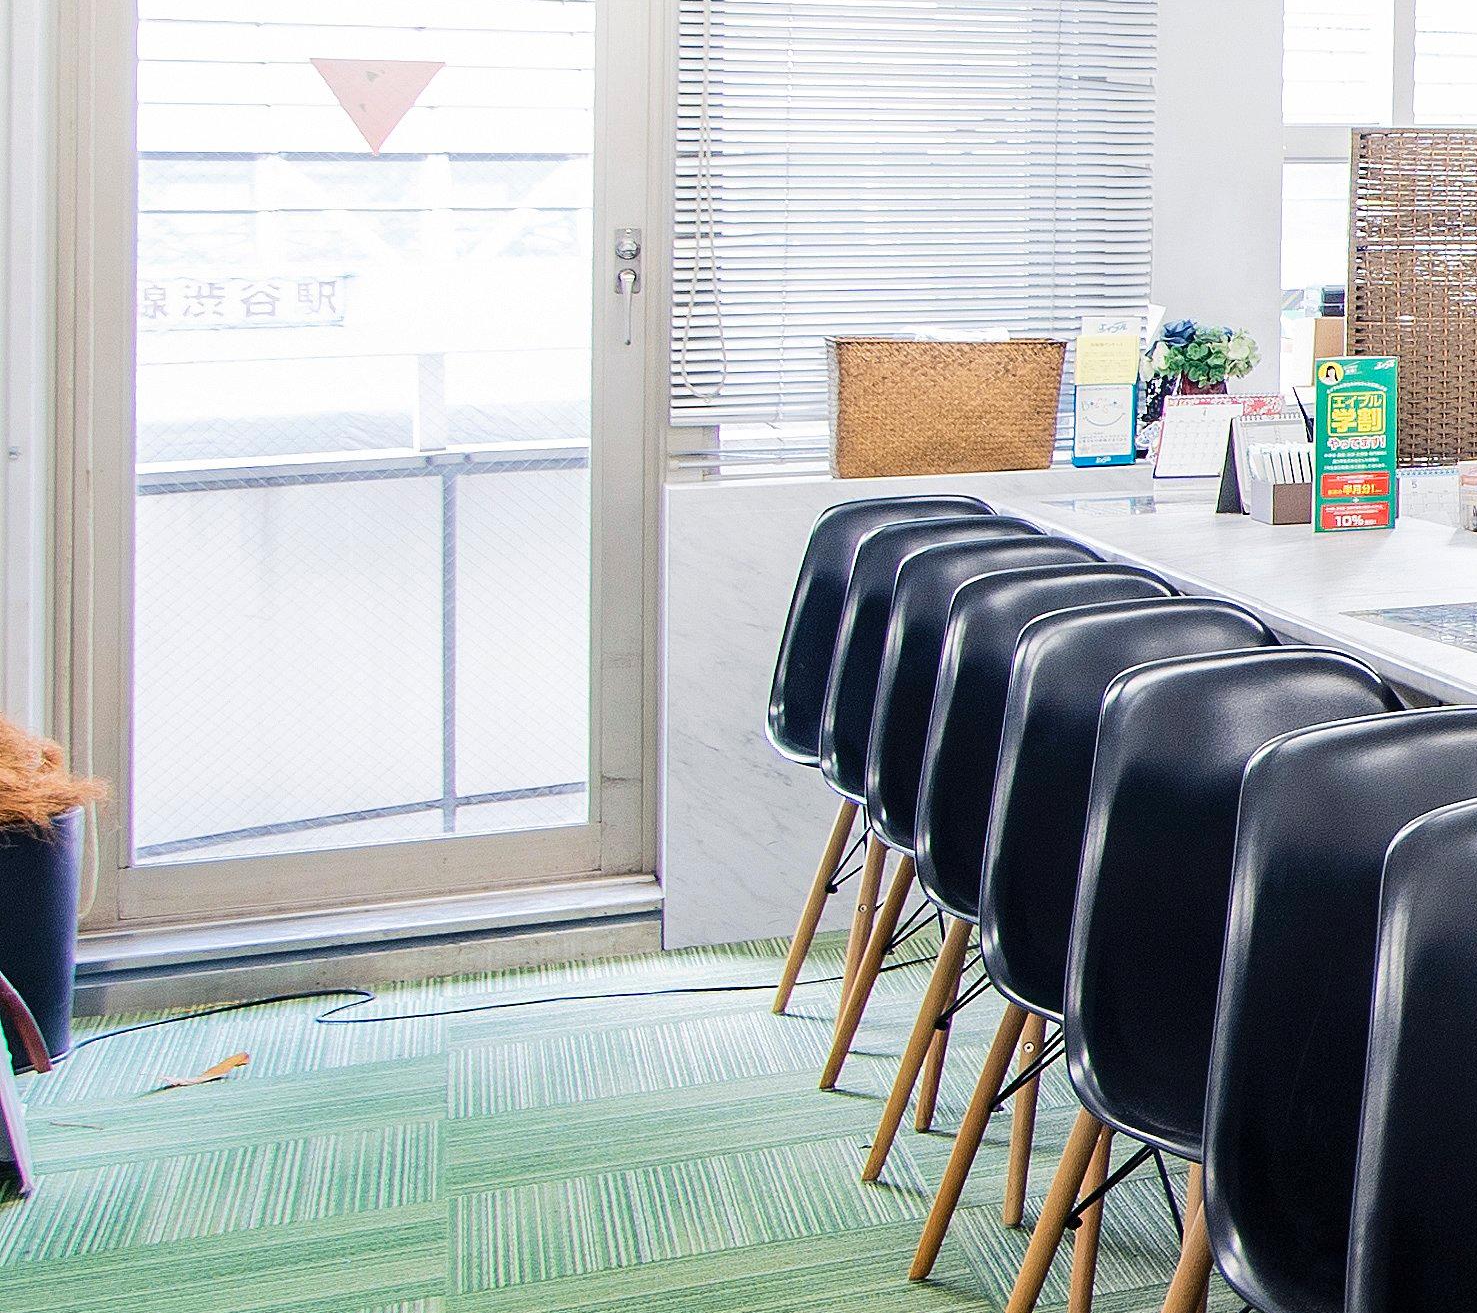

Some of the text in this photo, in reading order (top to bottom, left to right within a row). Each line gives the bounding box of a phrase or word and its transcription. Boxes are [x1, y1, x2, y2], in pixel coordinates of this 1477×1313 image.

[1332, 394, 1383, 408] エイブル
[1331, 407, 1383, 434] 学割
